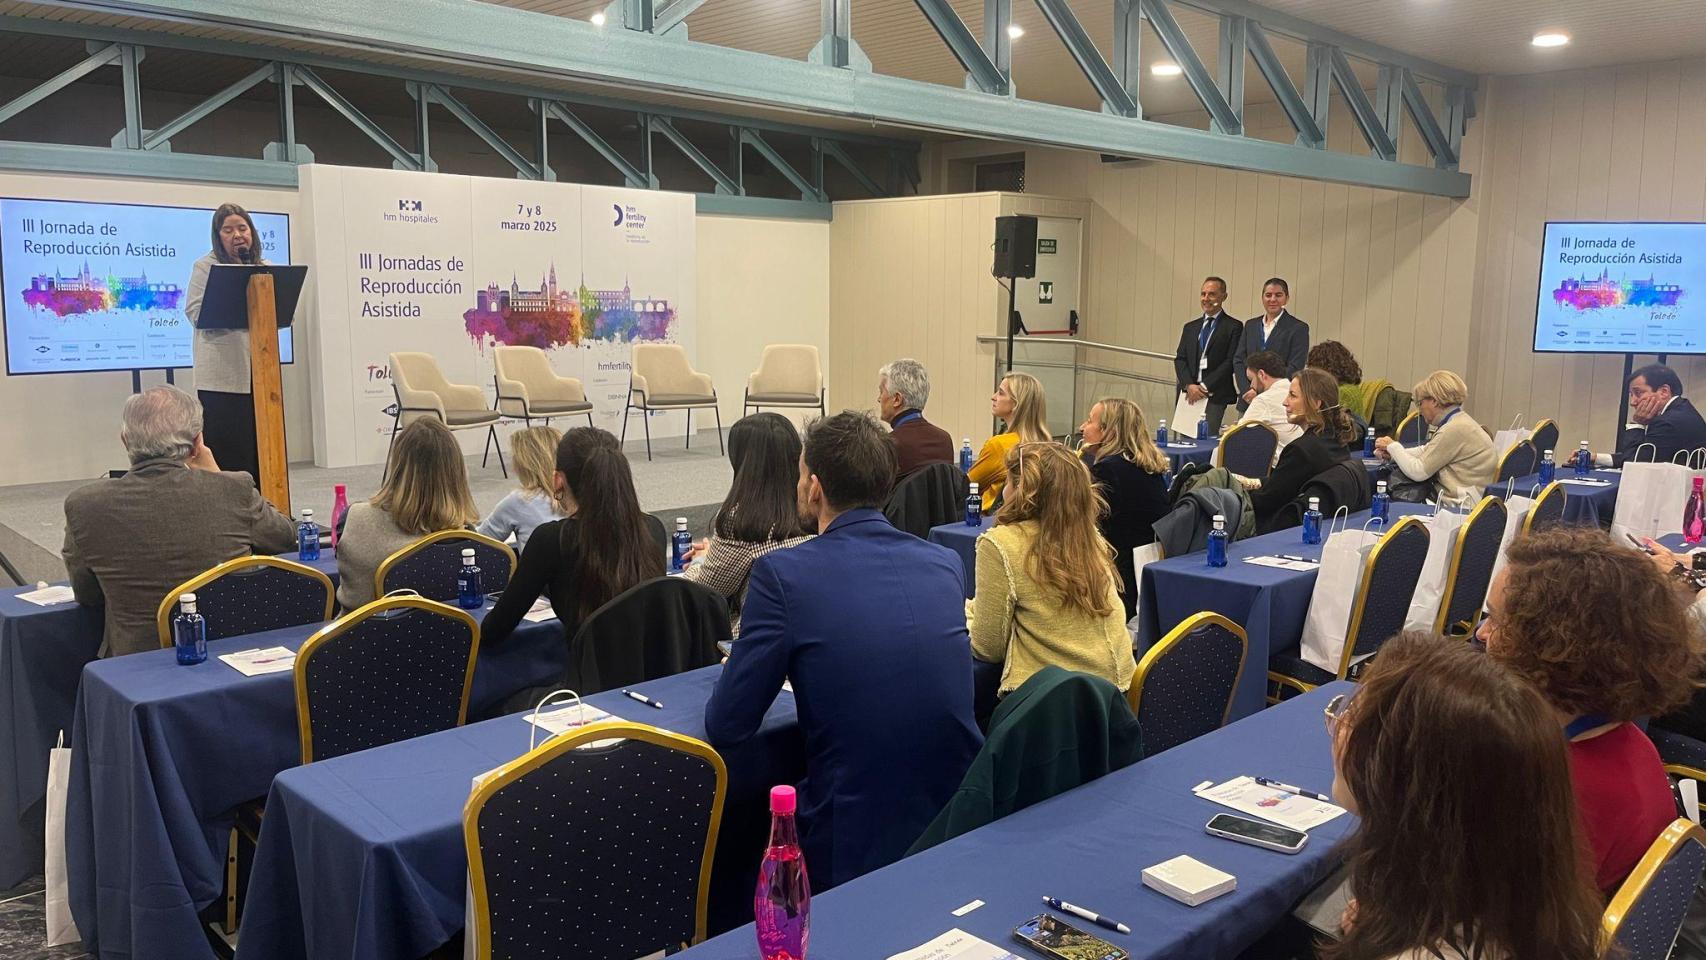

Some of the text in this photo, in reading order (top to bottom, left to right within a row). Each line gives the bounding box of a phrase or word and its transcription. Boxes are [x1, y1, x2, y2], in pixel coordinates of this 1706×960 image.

[517, 204, 541, 217] 7 y 8
[625, 204, 636, 212] hm
[383, 211, 439, 224] hm hospitales
[22, 218, 117, 236] III Jornada de
[501, 220, 557, 232] marzo 2025
[625, 221, 645, 229] center
[269, 230, 275, 239] 8
[23, 239, 176, 258] Reproducción Asistida
[1561, 237, 1636, 250] III Jornada de
[359, 253, 464, 273] III Jornadas de
[1559, 252, 1682, 266] Reproducción Asistida
[361, 276, 462, 298] Reproducción
[362, 300, 421, 318] Asistida
[1650, 310, 1677, 321] Toledo
[148, 316, 179, 328] Toledo
